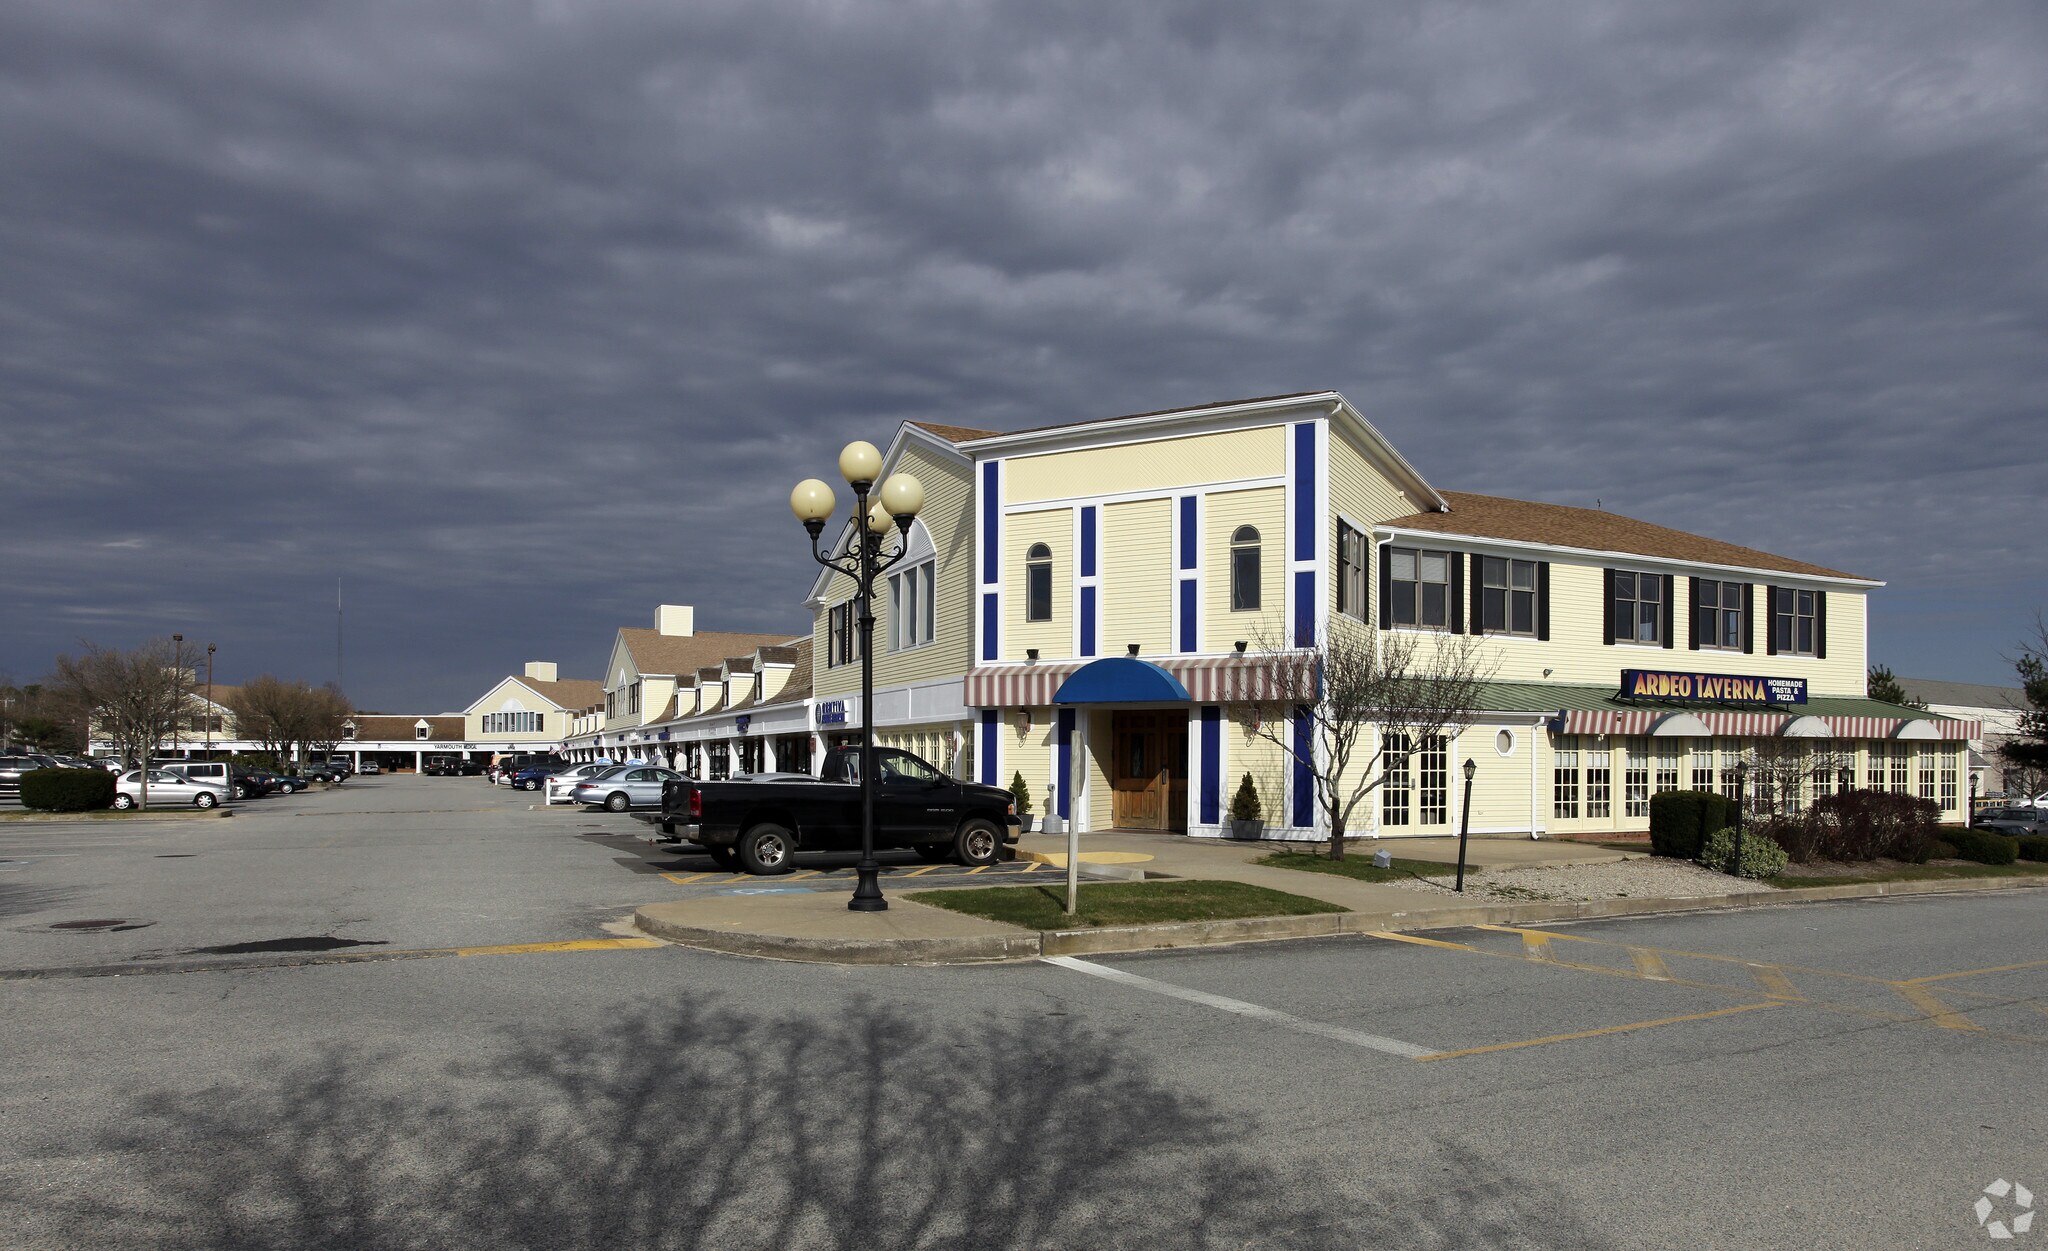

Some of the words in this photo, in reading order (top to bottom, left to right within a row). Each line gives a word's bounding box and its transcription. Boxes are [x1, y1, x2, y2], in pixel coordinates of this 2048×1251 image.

[1633, 673, 1691, 697] ARDEO
[1695, 674, 1766, 700] TAVERNA
[1772, 686, 1792, 694] PASTA
